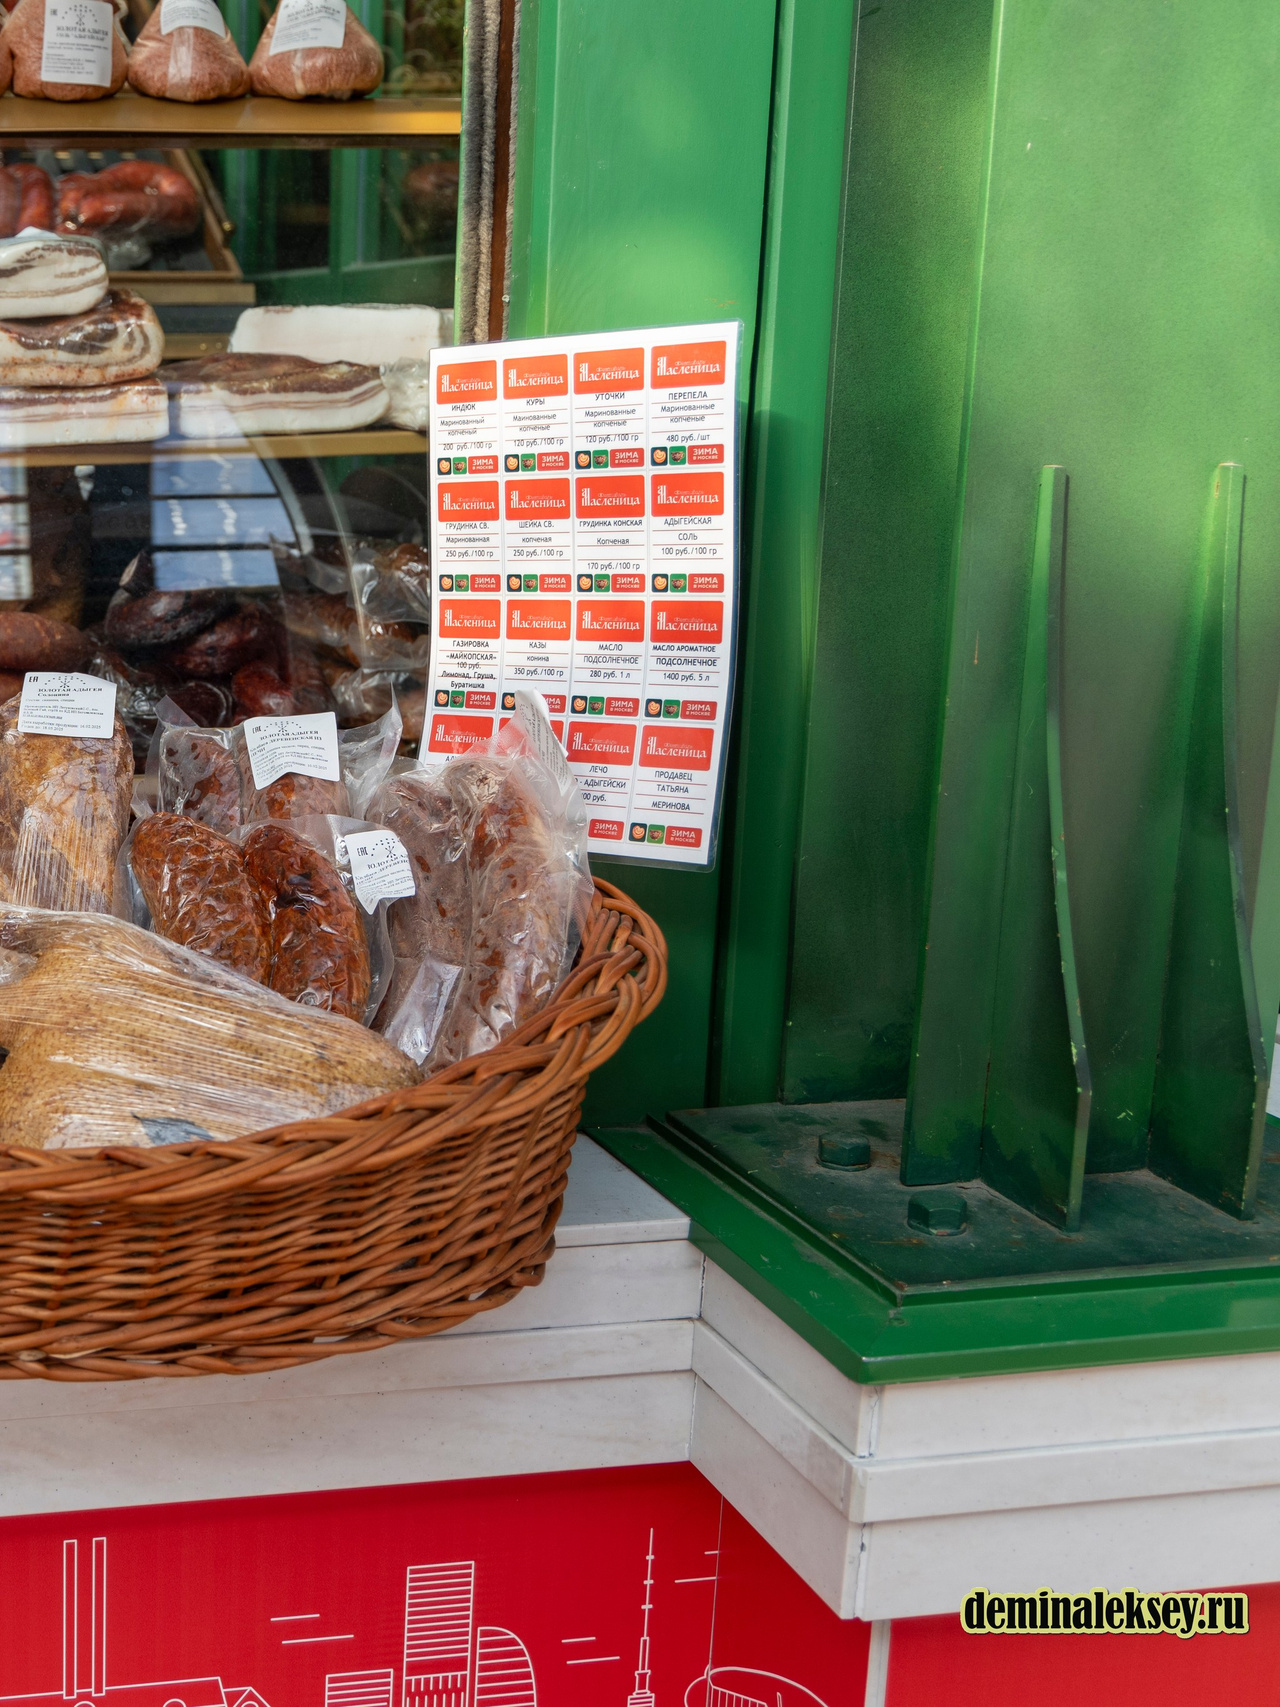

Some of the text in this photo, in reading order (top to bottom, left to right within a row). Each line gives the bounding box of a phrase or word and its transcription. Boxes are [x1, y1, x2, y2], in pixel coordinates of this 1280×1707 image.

[657, 356, 720, 376] Масленица
[580, 363, 640, 382] Масленица
[441, 374, 493, 392] Масленица
[508, 369, 564, 388] Масленица
[595, 392, 625, 401] УТОЧКИ
[668, 391, 708, 400] ПЕРЕПЕЛА
[527, 398, 545, 406] КУРЫ
[452, 403, 476, 412] ИНДЮК
[661, 403, 715, 413] Маринованные
[513, 413, 557, 421] Маинованные
[585, 408, 636, 417] Маринованные
[440, 417, 484, 427] Маринованный
[670, 415, 705, 423] копченые
[519, 424, 551, 432] копченые
[594, 420, 627, 428] копченые
[448, 428, 477, 436] копченый
[514, 439, 525, 447] 120
[527, 438, 554, 448] руб./100
[599, 434, 628, 444] руб./100
[630, 434, 639, 443] гр
[681, 434, 710, 443] руб./шт
[443, 443, 454, 451] 200
[457, 442, 482, 451] руб./100
[616, 451, 638, 460] ЗИМА
[692, 447, 718, 456] ЗИМА
[472, 458, 493, 467] ЗИМА
[542, 455, 564, 463] ЗИМА
[510, 490, 566, 508] Масленица
[582, 488, 640, 506] Масленица
[657, 485, 719, 504] Масленица
[443, 492, 495, 511] Масленица
[519, 520, 541, 528] ШЕЙКА
[580, 519, 642, 528] ГРУДИНКА КОНСКАЯ
[664, 516, 712, 526] АДЫГЕЙСКАЯ
[446, 522, 489, 530] ГРУДИНКА СВ.
[446, 536, 490, 544] Маринованная
[597, 537, 629, 545] Копченая
[678, 533, 698, 541] СОЛЬ
[446, 550, 456, 558] 250
[459, 550, 484, 559] руб./100
[526, 549, 553, 558] руб./100
[556, 550, 563, 558] гр
[661, 546, 717, 556] 100 руб./100 гр
[600, 562, 630, 571] руб./100
[632, 563, 640, 571] гр
[444, 609, 496, 628] Масленица
[512, 610, 567, 629] Масленица
[582, 611, 640, 630] Масленица
[657, 612, 718, 632] Масленица
[453, 640, 489, 648] ГАЗИРОВКА
[678, 645, 716, 653] АРОМАТНОЕ
[584, 656, 638, 665] ПОДСОЛНЕЧНОЕ
[656, 658, 717, 667] ПОДСОЛНЕЧНОЕ
[441, 671, 496, 680] Лимонад, Груша,
[527, 667, 554, 676] руб./100
[556, 669, 563, 677] гр
[603, 672, 618, 680] руб.
[663, 673, 679, 681] 1400
[681, 674, 698, 682] руб.
[451, 681, 485, 689] Буратишка
[611, 699, 634, 708] ЗИМА
[687, 704, 711, 712] ЗИМА
[573, 732, 630, 754] Масленица
[647, 736, 706, 758] Масленица
[590, 765, 608, 774] ЛЕЧО
[655, 771, 692, 782] ПРОДАВЕЦ
[584, 779, 626, 789] АДЫГЕЙСКИ
[657, 784, 689, 794] ТАТЬЯНА
[593, 794, 607, 803] руб.
[652, 801, 690, 811] МЕРИНОВА
[595, 822, 618, 831] ЗИМА
[671, 829, 696, 838] ЗИМА
